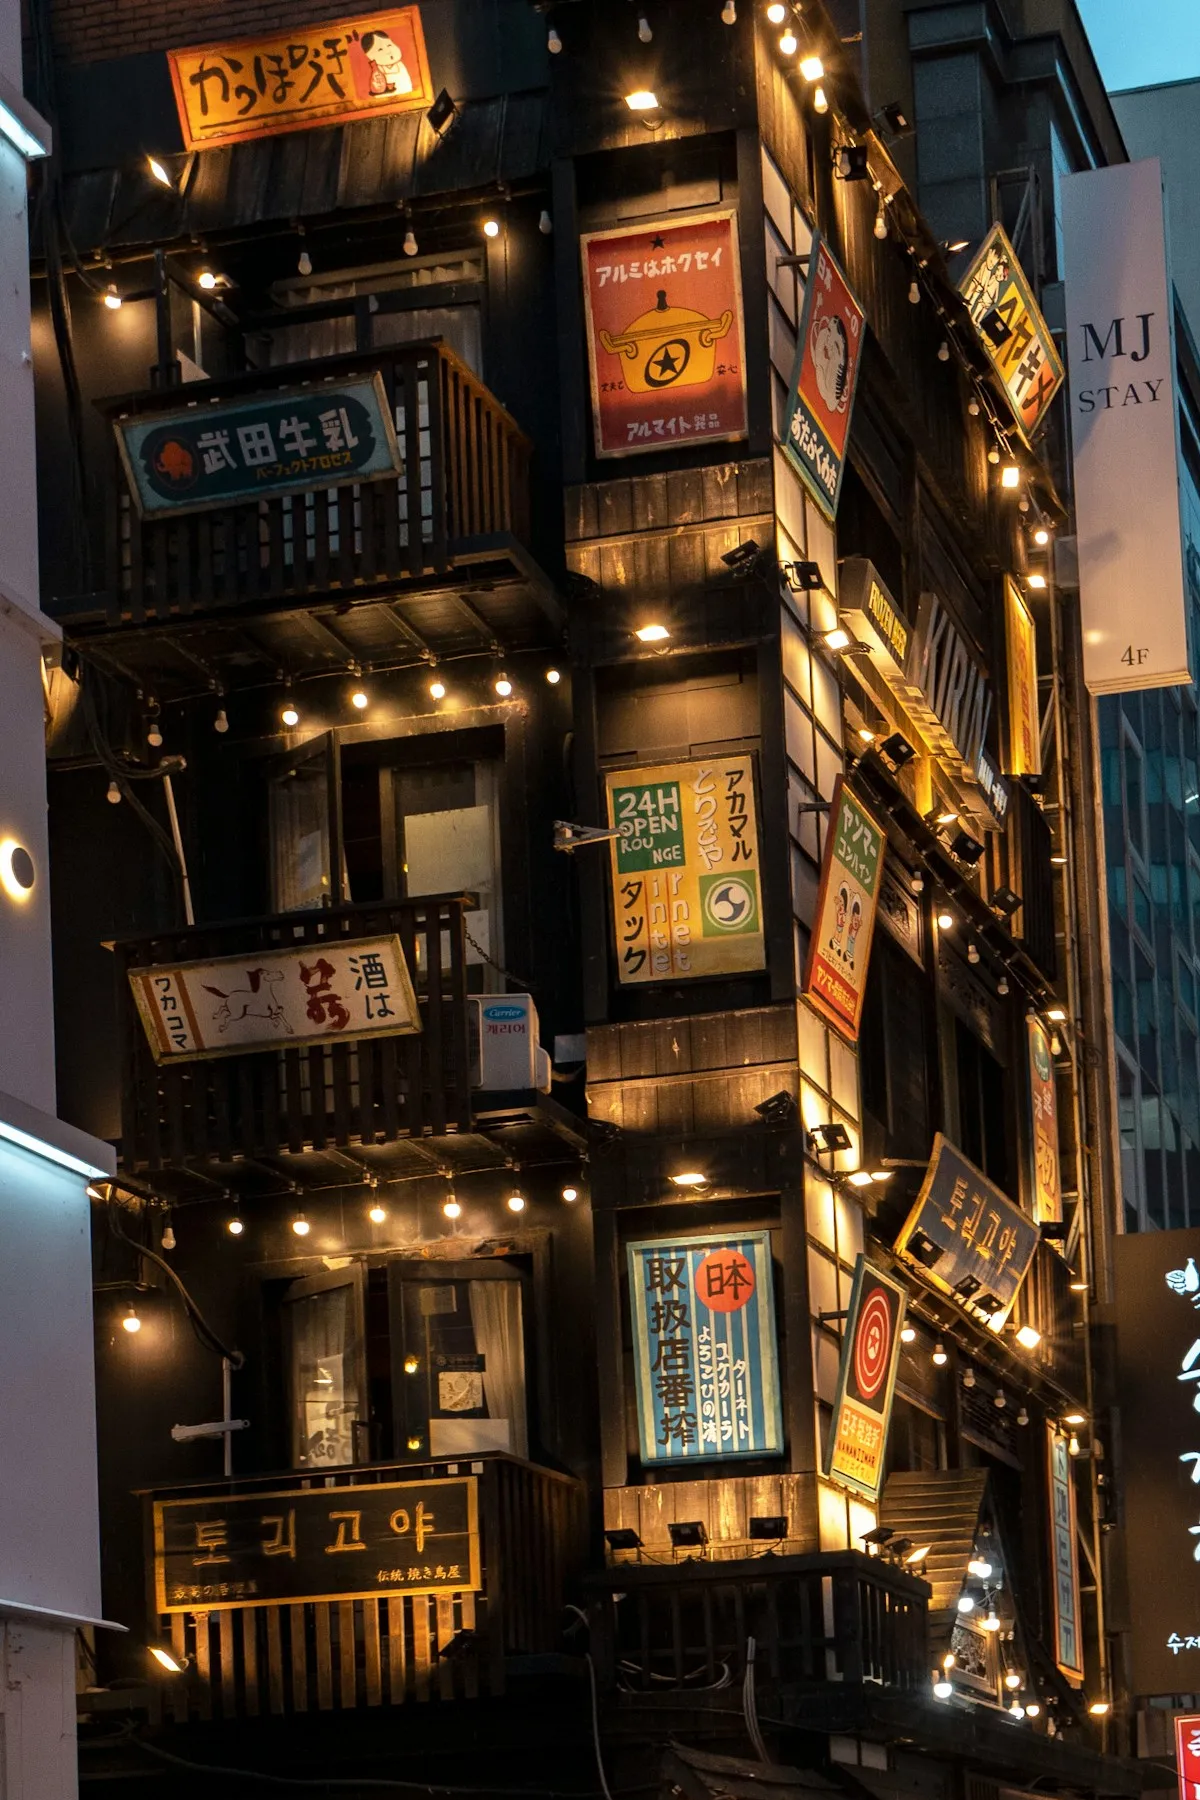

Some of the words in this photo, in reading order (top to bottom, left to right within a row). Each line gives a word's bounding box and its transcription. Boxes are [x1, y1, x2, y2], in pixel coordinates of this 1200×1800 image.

[595, 246, 723, 288] アルミはホクセイ
[1079, 312, 1156, 363] MJ
[1078, 378, 1164, 414] STAY
[197, 407, 359, 475] 武田牛乳
[1120, 645, 1150, 667] 4F
[618, 786, 679, 819] 24H
[725, 769, 753, 862] アカマル
[618, 813, 678, 837] OPEN
[620, 836, 654, 854] ROU
[653, 845, 682, 864] NGE
[620, 880, 647, 975] タック
[348, 952, 396, 1019] 酒は
[154, 977, 189, 1049] ワカコマ
[489, 1008, 522, 1018] Carrier
[706, 1259, 753, 1301] 日本
[192, 1500, 435, 1567] 토리고야
